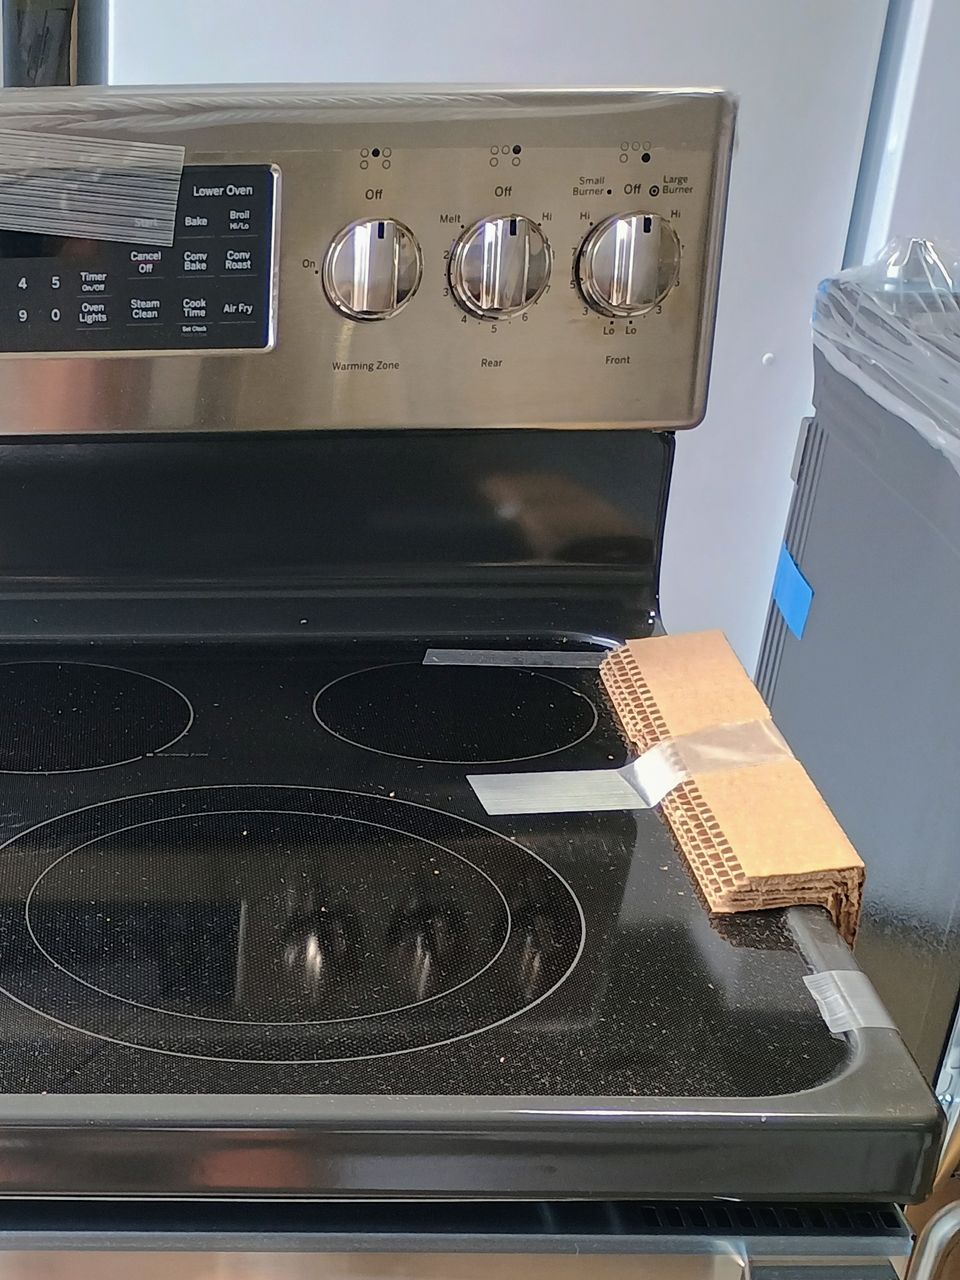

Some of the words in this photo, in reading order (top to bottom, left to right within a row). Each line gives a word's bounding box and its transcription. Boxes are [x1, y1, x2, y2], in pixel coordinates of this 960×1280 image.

[579, 176, 605, 185] Small
[663, 174, 688, 186] Large
[193, 186, 224, 197] Lower
[226, 185, 253, 196] Oven
[365, 188, 383, 200] Off
[495, 186, 513, 198] Off
[572, 186, 604, 196] Burner
[624, 183, 641, 195] Off
[662, 184, 693, 195] Burner
[230, 210, 250, 220] Broil
[440, 214, 461, 223] Melt
[542, 212, 552, 221] Hi
[580, 212, 590, 220] Hi
[671, 210, 681, 218] Hi
[185, 217, 208, 226] Bake
[230, 222, 250, 230] Hi/Lo
[130, 251, 162, 261] Cancel
[184, 252, 208, 260] Conv
[226, 250, 250, 260] Conv
[138, 264, 153, 273] Off
[184, 261, 207, 270] Bake
[226, 260, 252, 270] Roast
[302, 258, 316, 269] On
[80, 272, 107, 282] Timer
[18, 278, 27, 289] 4
[51, 276, 60, 288] 5
[82, 284, 105, 292] On/Off
[82, 303, 104, 312] Oven
[130, 299, 160, 308] Steam
[183, 298, 206, 308] Cook
[132, 309, 158, 318] Clean
[183, 308, 206, 318] Time
[224, 304, 237, 313] Air
[238, 303, 254, 316] Fry
[18, 310, 28, 321] 9
[50, 309, 60, 321] 0
[80, 313, 107, 324] Lights
[461, 314, 467, 323] 4
[491, 324, 497, 333] 5
[603, 326, 615, 335] Lo
[626, 326, 637, 334] Lo
[481, 358, 503, 368] Rear
[605, 355, 631, 365] Front
[332, 360, 374, 372] Warming
[376, 360, 400, 370] Zone
